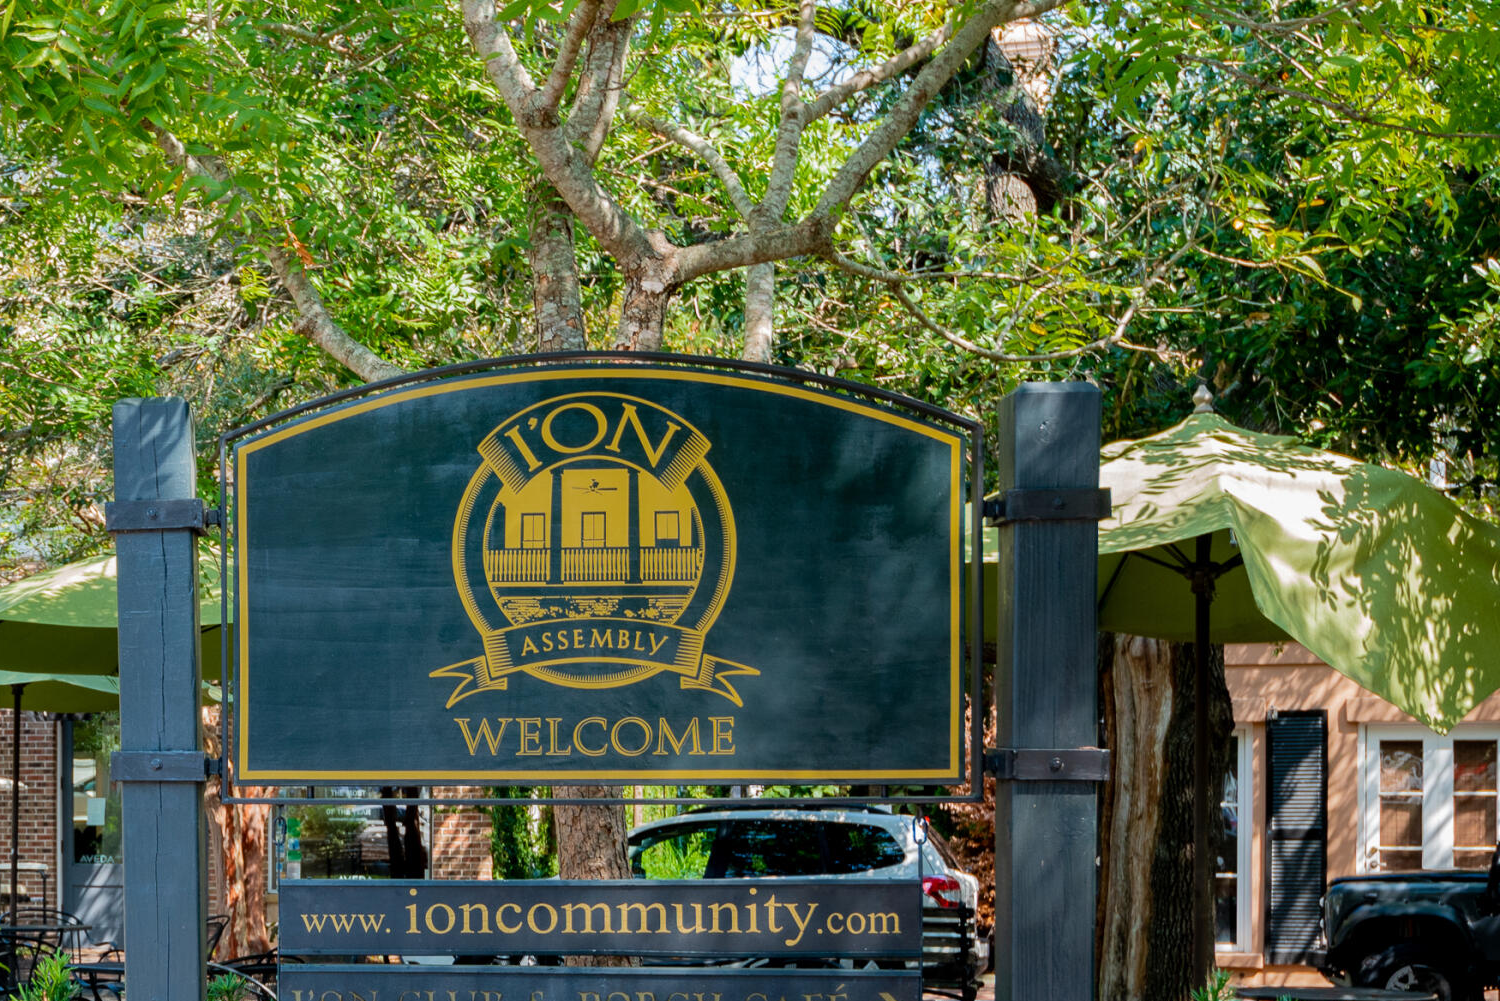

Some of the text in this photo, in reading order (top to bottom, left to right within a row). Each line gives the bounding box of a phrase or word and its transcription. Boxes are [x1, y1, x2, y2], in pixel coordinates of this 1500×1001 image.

[503, 402, 682, 473] I'ON
[520, 628, 669, 657] ASSEMBLY
[452, 716, 737, 757] WELCOME
[80, 855, 115, 864] AVEDA
